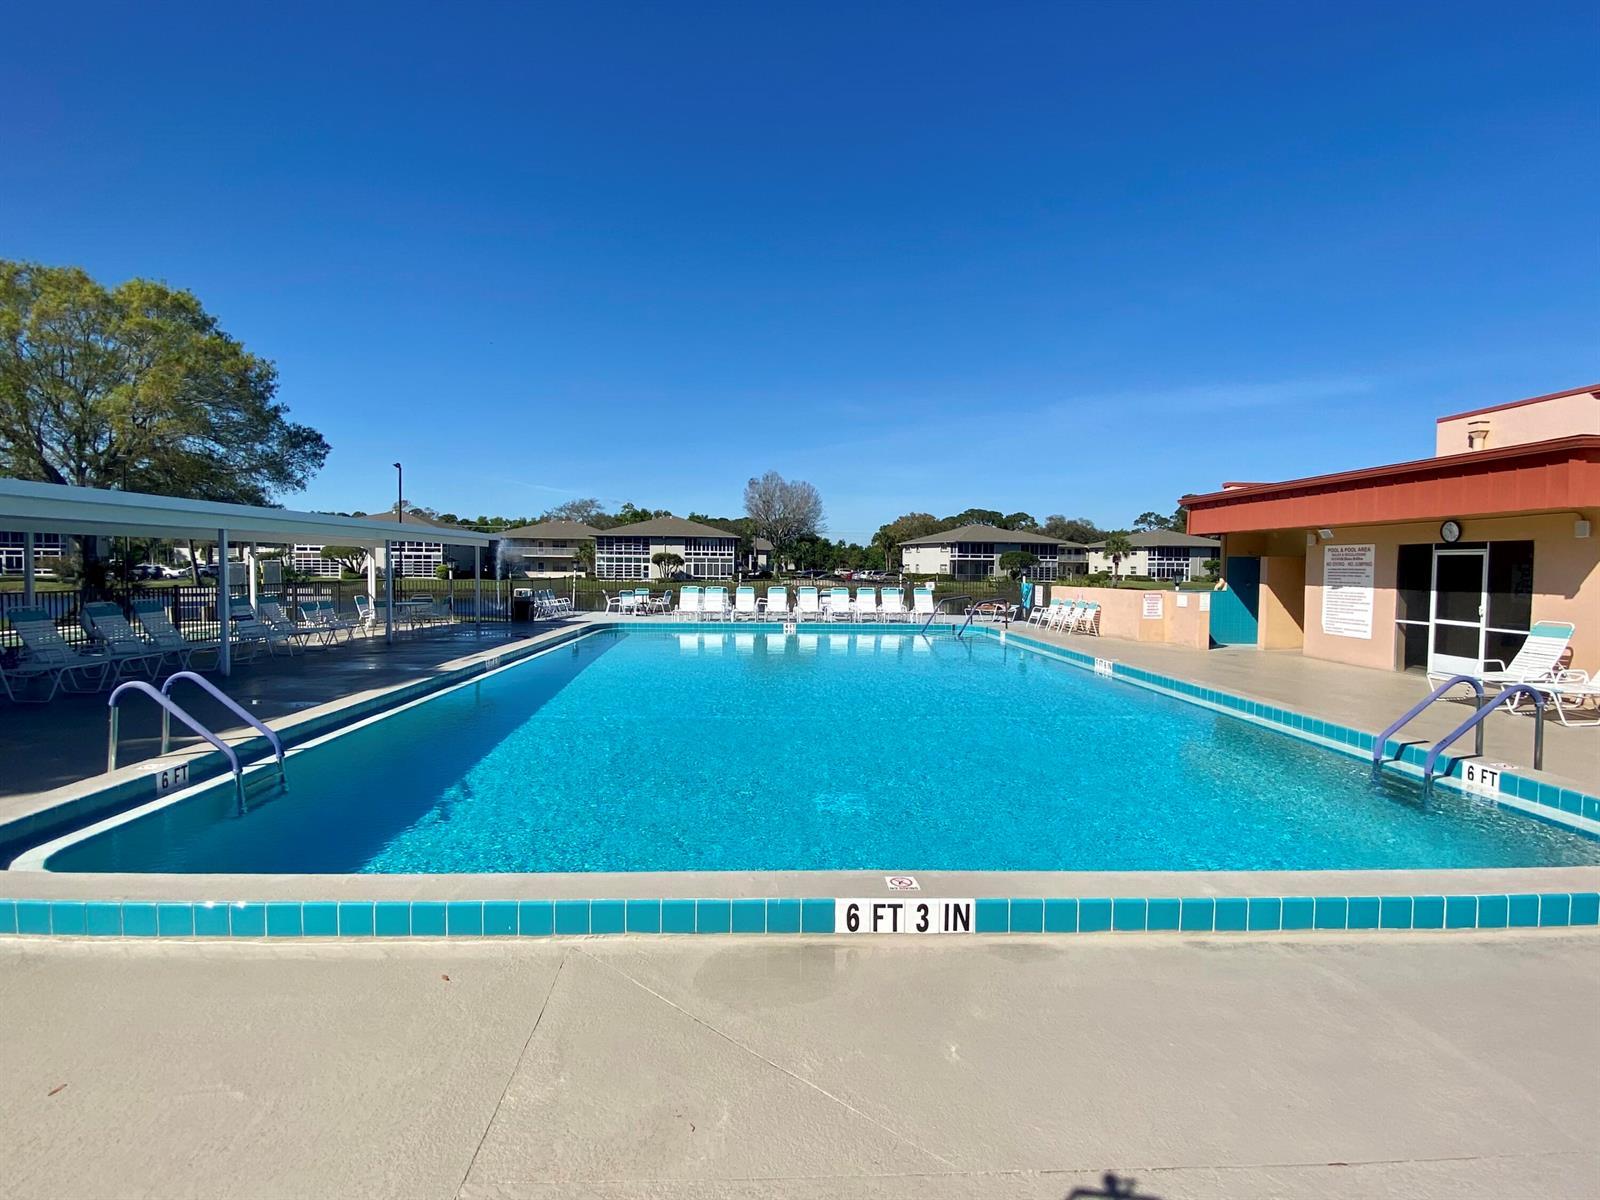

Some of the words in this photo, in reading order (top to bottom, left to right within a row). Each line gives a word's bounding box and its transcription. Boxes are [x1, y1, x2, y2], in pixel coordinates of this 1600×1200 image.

[162, 771, 169, 789] 6
[174, 764, 188, 784] FT
[1467, 765, 1475, 781] 6
[1480, 769, 1498, 787] FT
[846, 903, 860, 932] 6
[872, 903, 904, 932] FT
[915, 903, 930, 932] 3
[944, 903, 971, 931] IN
